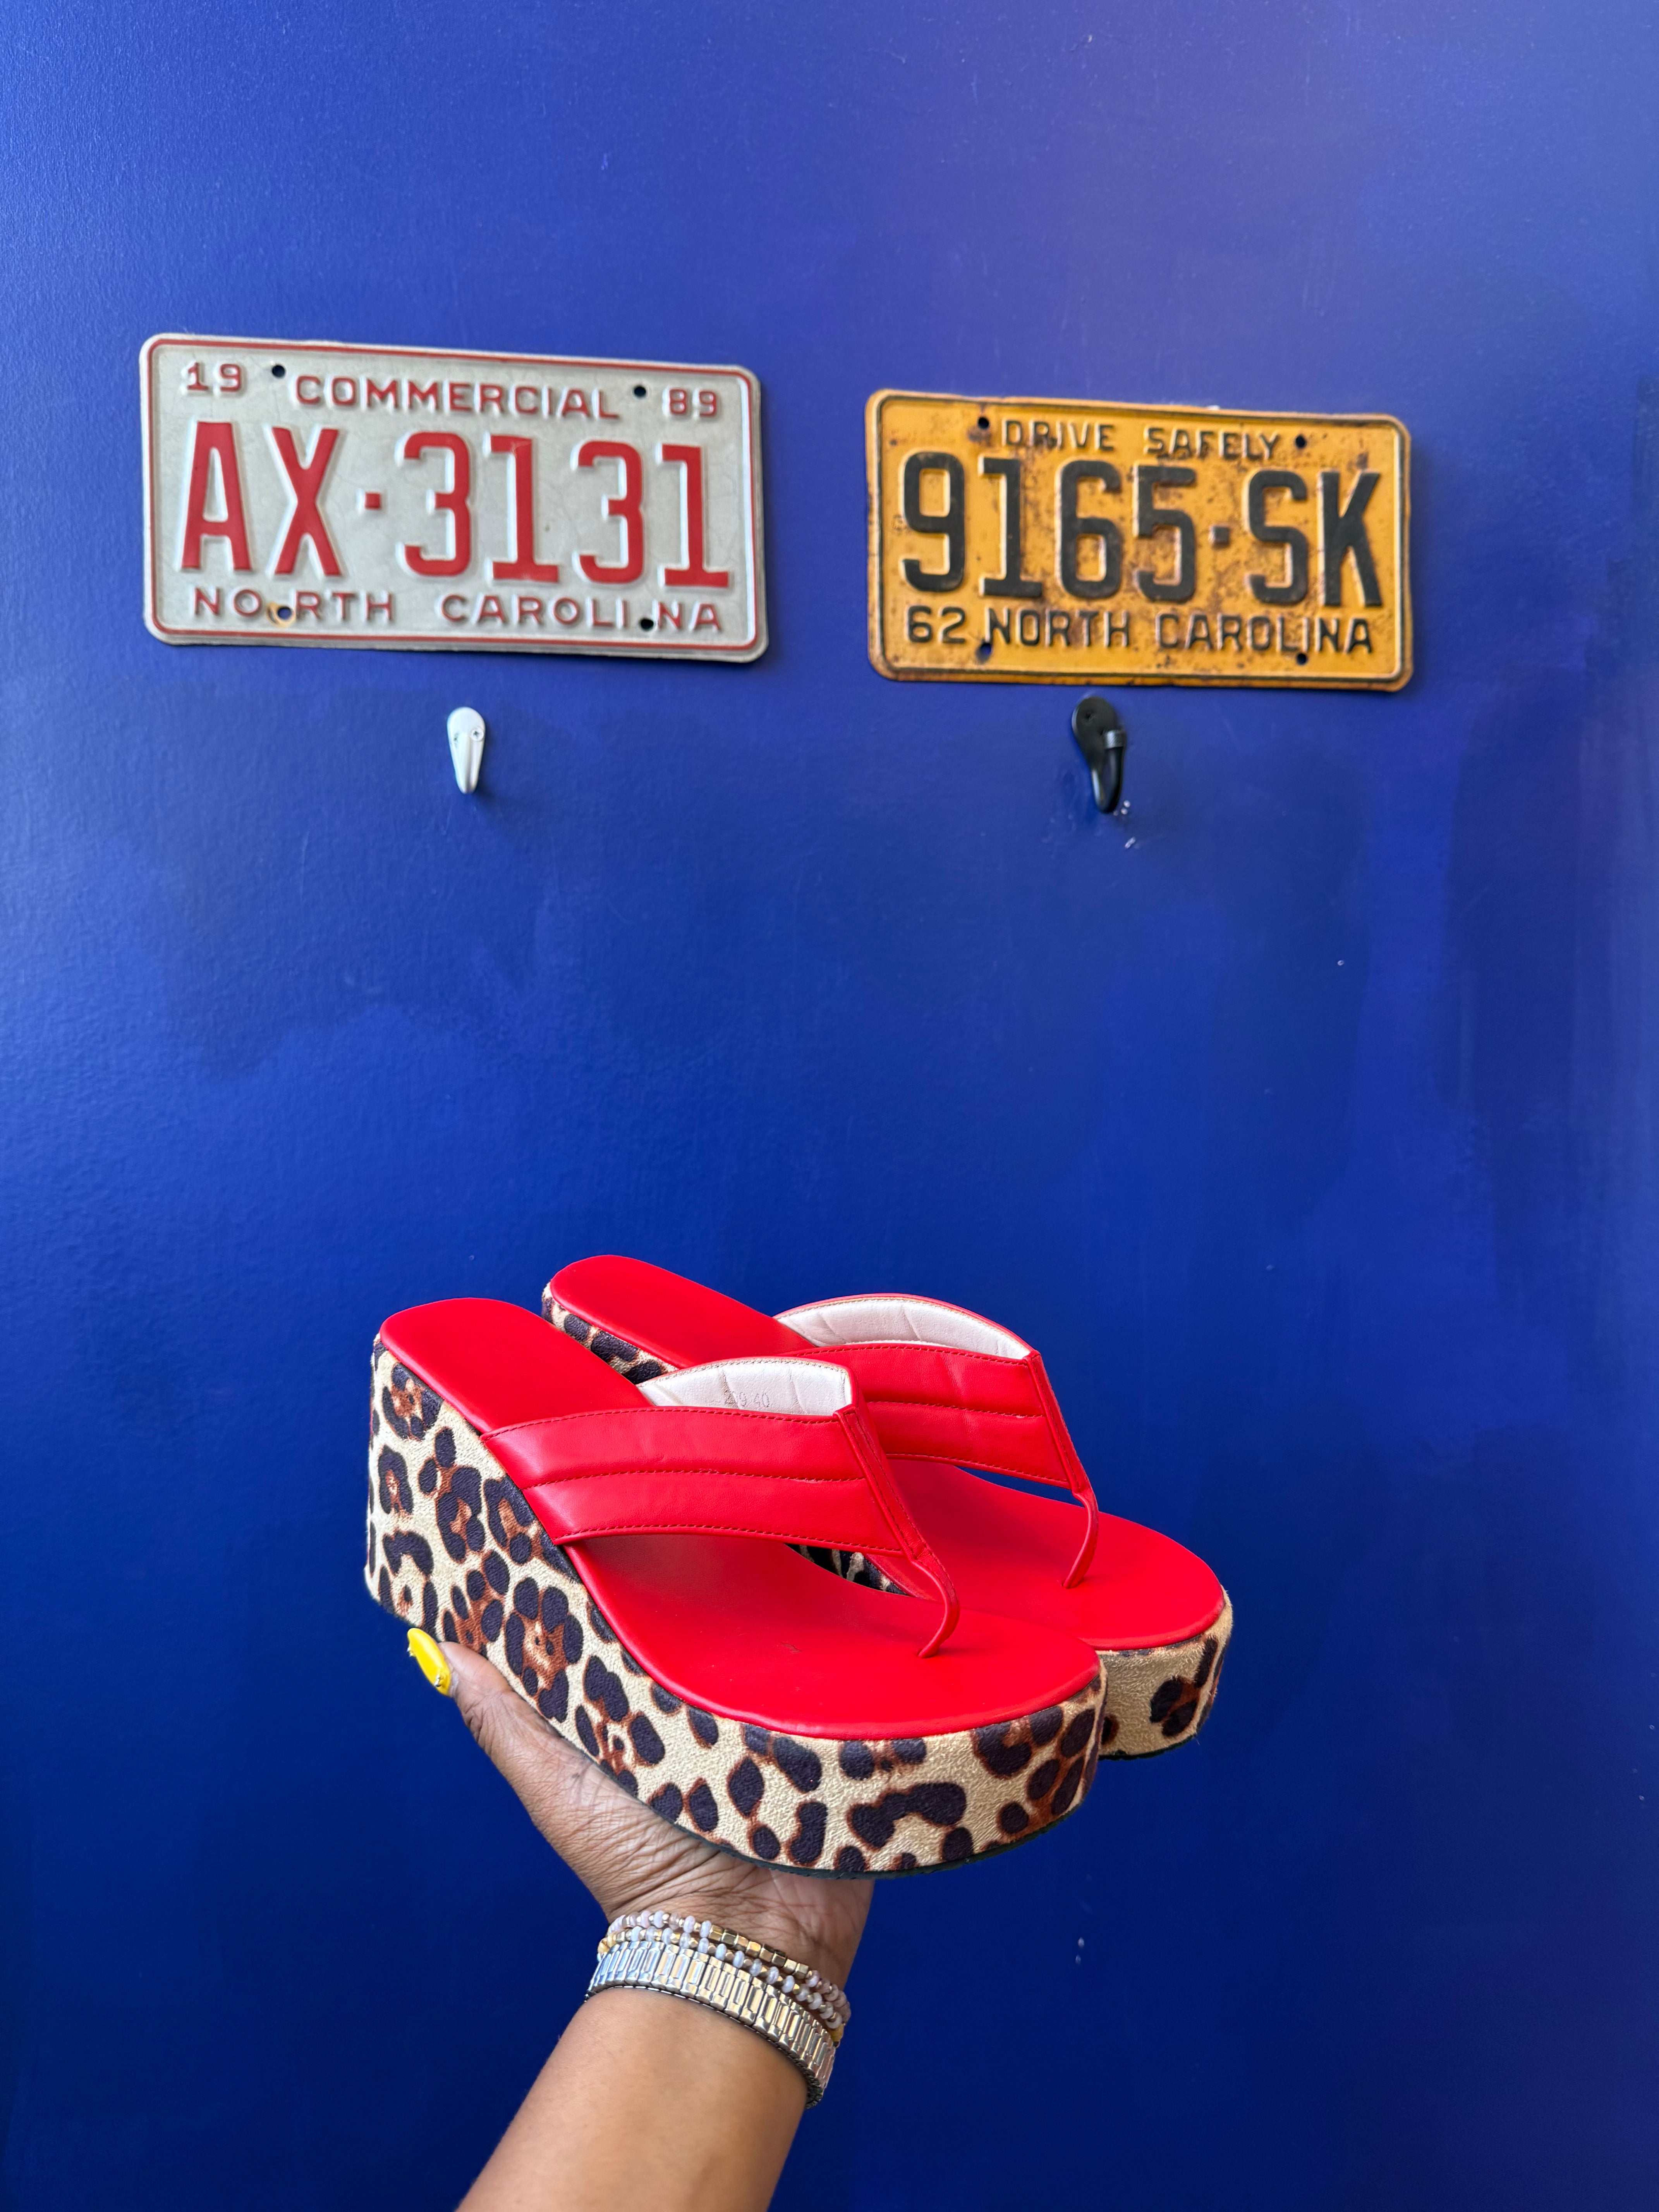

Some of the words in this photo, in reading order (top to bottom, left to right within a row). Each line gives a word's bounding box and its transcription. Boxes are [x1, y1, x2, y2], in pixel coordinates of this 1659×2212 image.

[186, 362, 242, 392] 19
[295, 375, 619, 419] COMMERCIAL
[668, 388, 718, 417] 89
[1002, 419, 1116, 452] DRIVE
[1144, 426, 1280, 460] SAFELY
[193, 587, 393, 620] NORTH
[441, 594, 722, 632] CAROLINA
[905, 605, 966, 644] 62
[984, 606, 1130, 647] NORTH
[1156, 612, 1373, 654] CAROLINA
